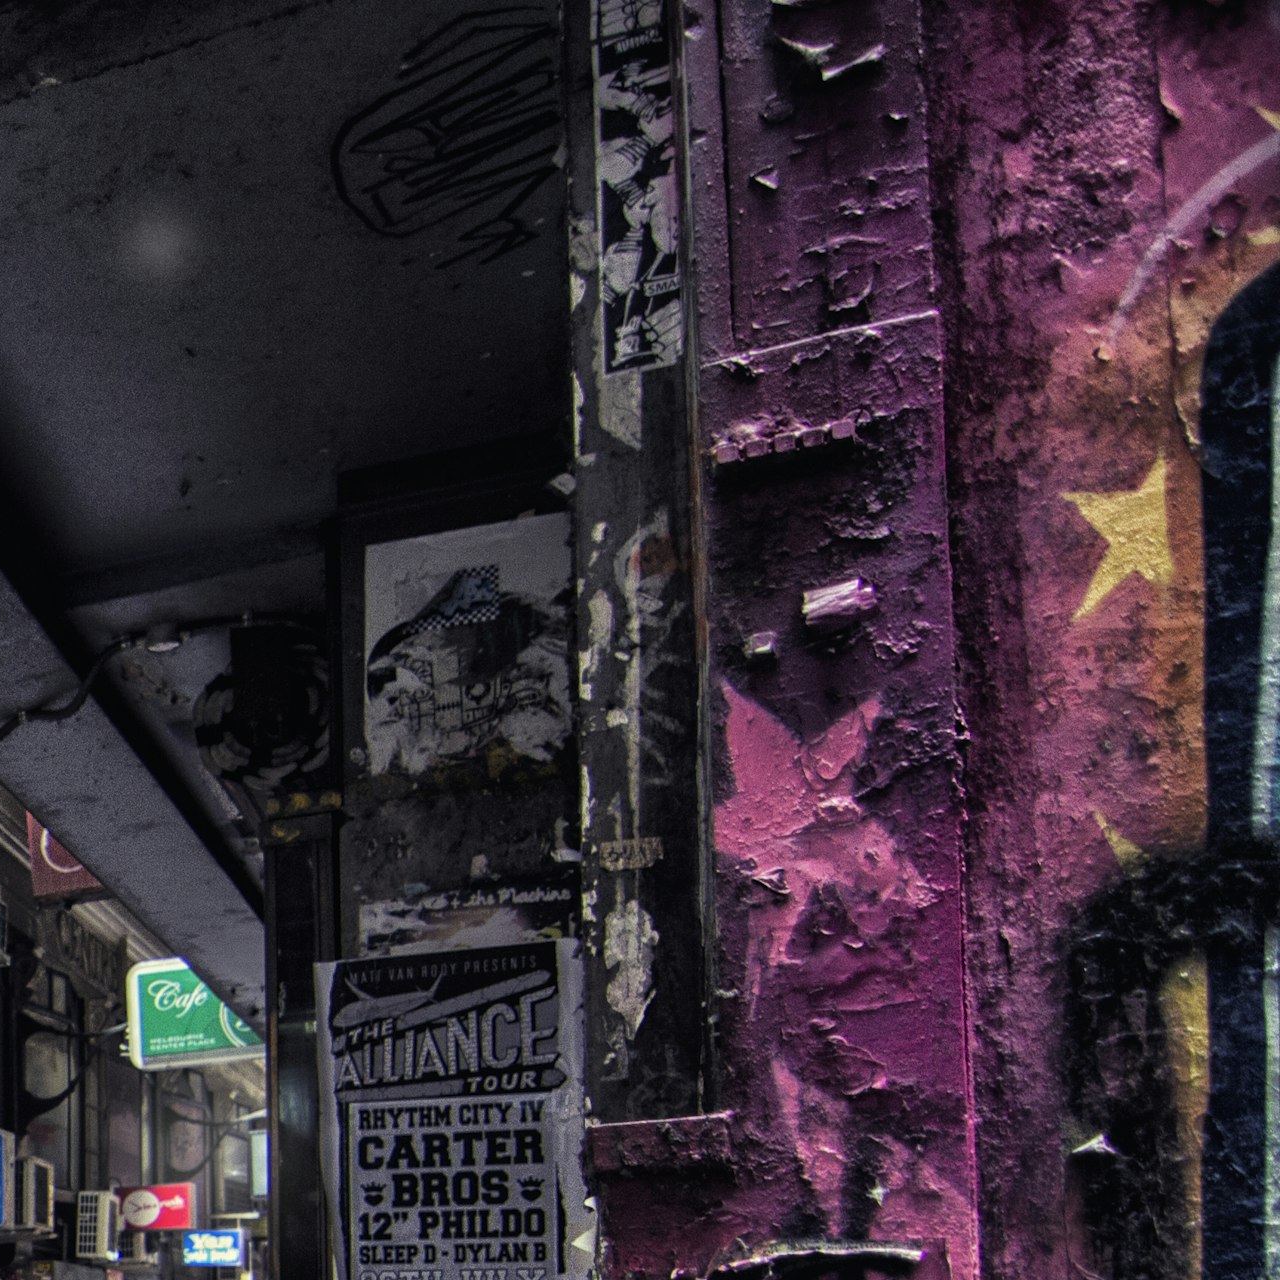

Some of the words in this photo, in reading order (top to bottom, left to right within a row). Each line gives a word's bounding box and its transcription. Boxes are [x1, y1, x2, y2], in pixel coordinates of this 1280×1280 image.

[463, 889, 495, 907] the
[498, 887, 572, 905] Machine
[390, 967, 414, 981] VAN
[464, 955, 537, 975] PRESENTS
[147, 979, 208, 1018] Cafe
[150, 1033, 204, 1044] MELBOURNE
[150, 1041, 185, 1050] CENTER
[188, 1037, 216, 1046] PLACE
[337, 985, 561, 1088] ALLIANCE
[349, 1018, 394, 1044] THE
[467, 1071, 537, 1093] TOUR
[358, 1105, 451, 1130] RHYTHM
[459, 1102, 513, 1126] CITY
[520, 1101, 545, 1123] IV
[358, 1129, 544, 1170] CARTER
[392, 1170, 509, 1208] BROS
[418, 1208, 546, 1240] PHILDO
[359, 1244, 418, 1265] SLEEP
[424, 1244, 437, 1263] D
[454, 1242, 528, 1264] DYLAN
[534, 1242, 547, 1262] B
